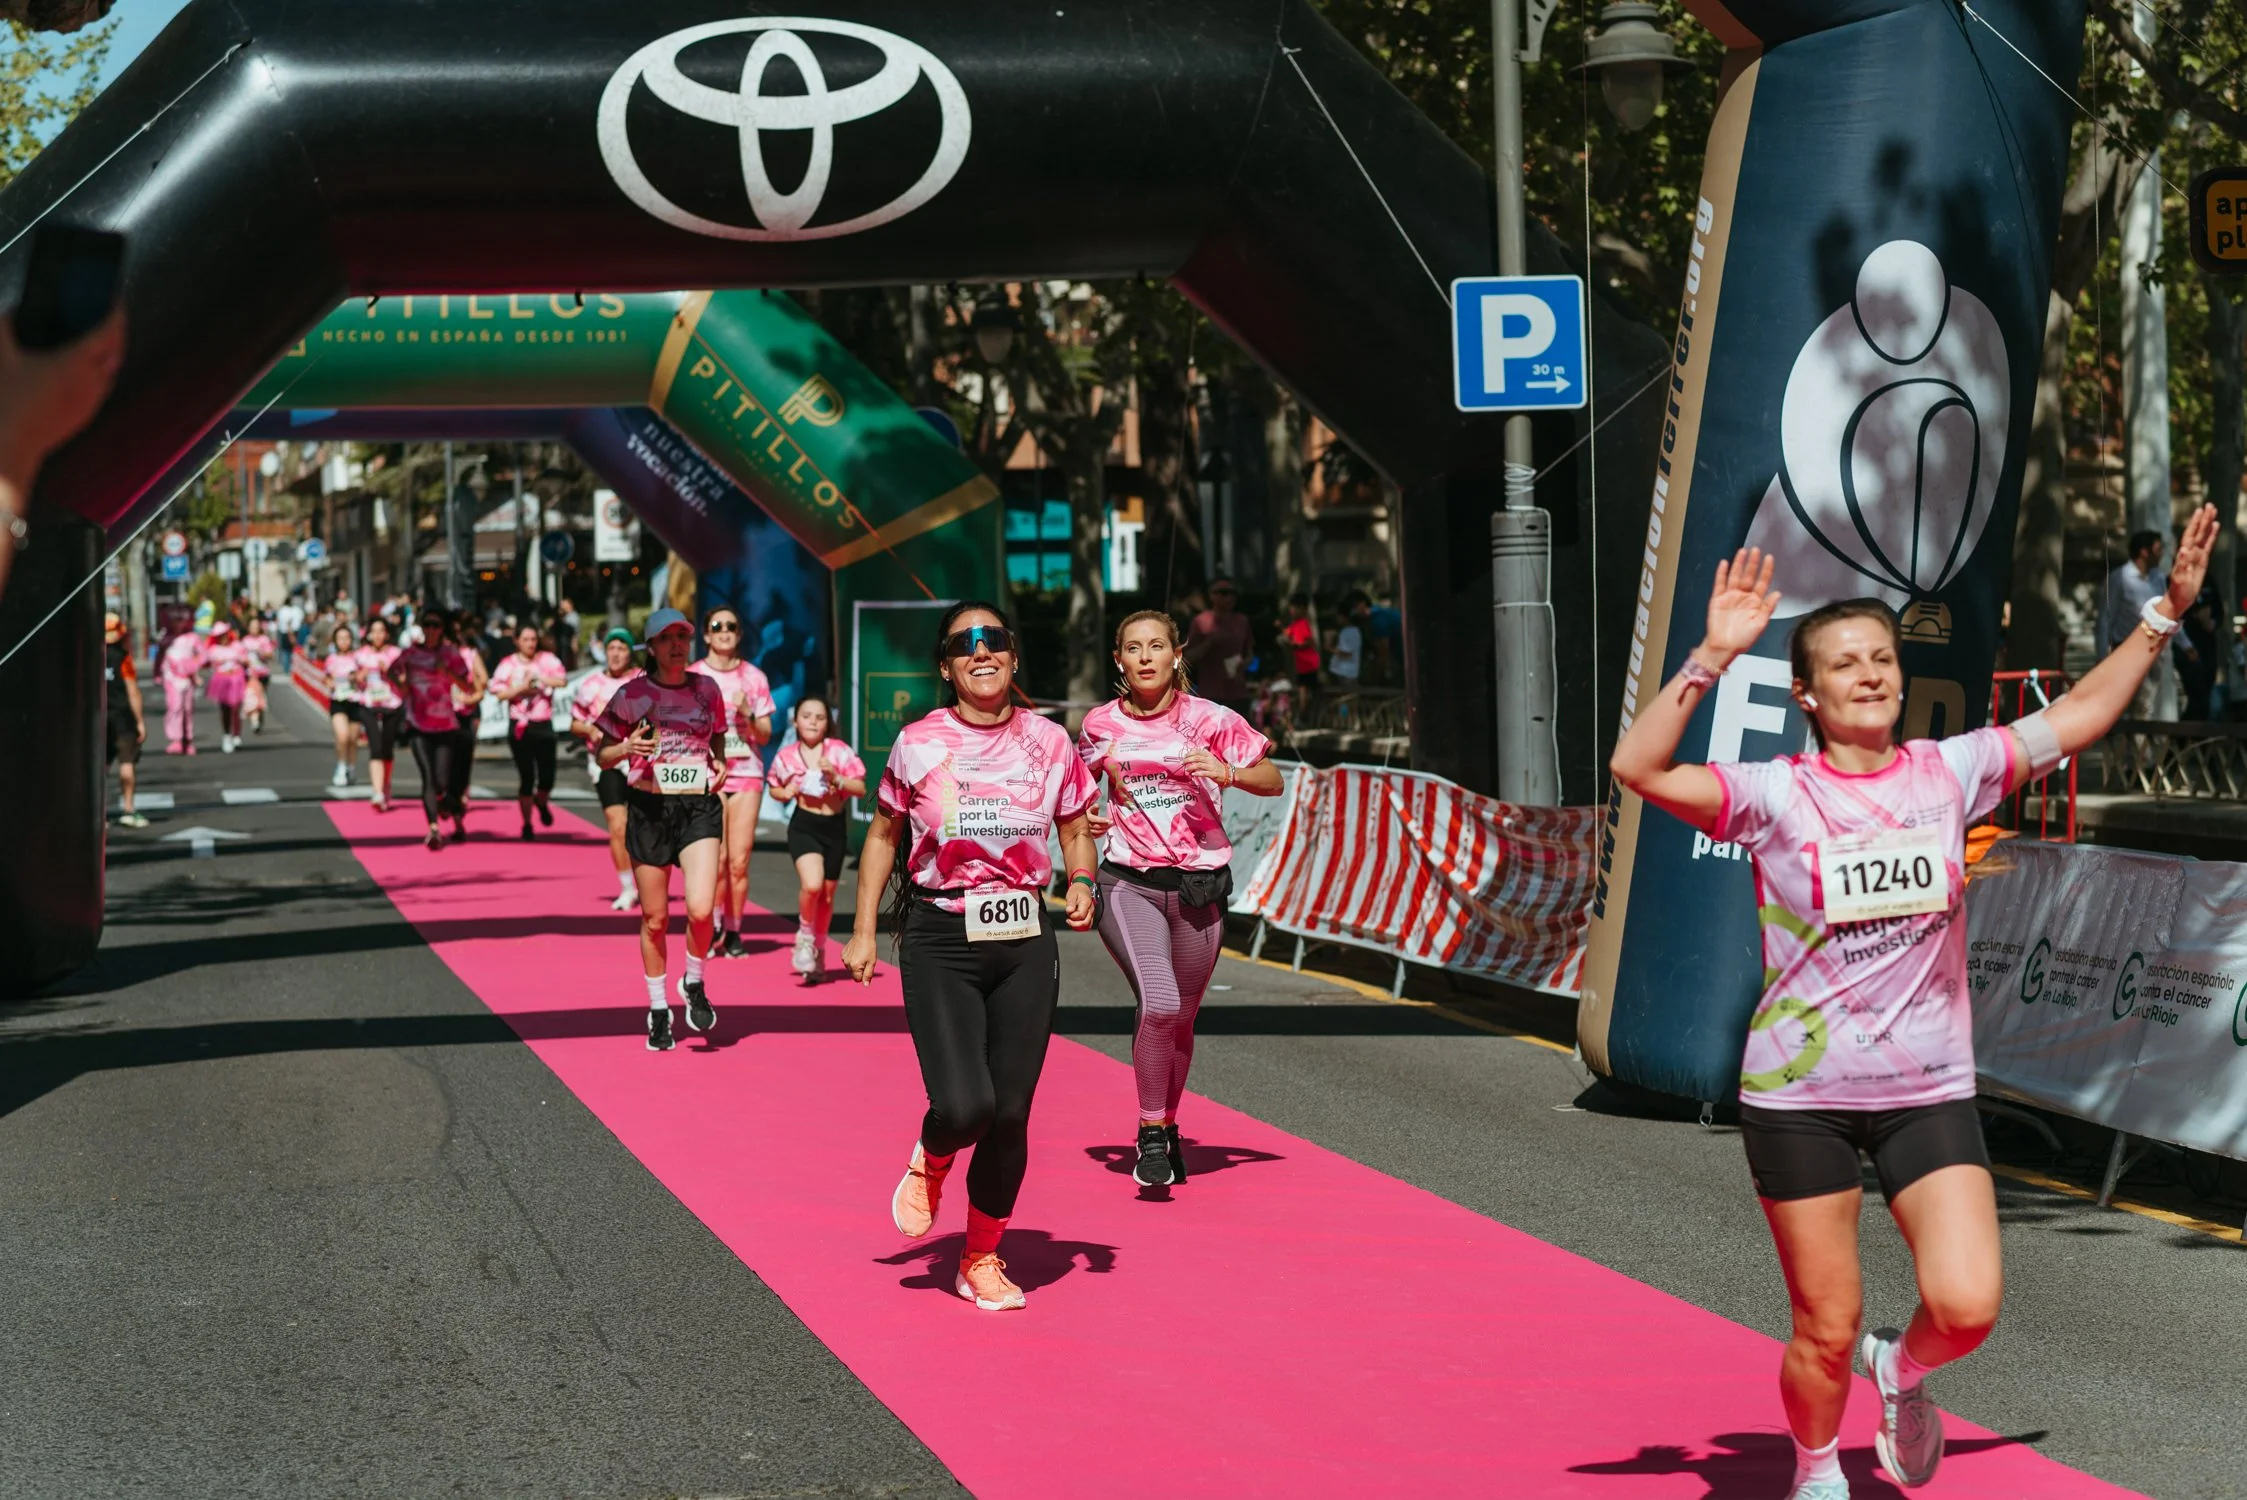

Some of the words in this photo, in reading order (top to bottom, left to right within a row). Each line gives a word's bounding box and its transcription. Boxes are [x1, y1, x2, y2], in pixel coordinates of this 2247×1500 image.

[322, 330, 385, 342] HECHO
[396, 330, 419, 342] EN
[430, 328, 503, 343] ESPAÑA
[515, 330, 575, 343] DESDE
[586, 330, 627, 342] 1981
[1480, 294, 1557, 394] P
[1532, 364, 1550, 376] 30
[1553, 365, 1565, 375] m
[690, 355, 855, 529] PITILLOS
[1118, 760, 1131, 772] XI
[661, 767, 698, 784] 3687
[1122, 772, 1167, 785] Carrera
[1145, 785, 1157, 795] la
[958, 795, 1010, 806] Carrera
[959, 811, 982, 824] por
[985, 810, 998, 821] la
[960, 824, 1043, 839] Investigación
[1834, 856, 1932, 895] 11240
[979, 897, 1030, 924] 6810
[2191, 971, 2235, 991] española
[2163, 986, 2176, 1001] el
[2176, 988, 2212, 1009] cáncer
[2150, 1005, 2180, 1028] Rioja
